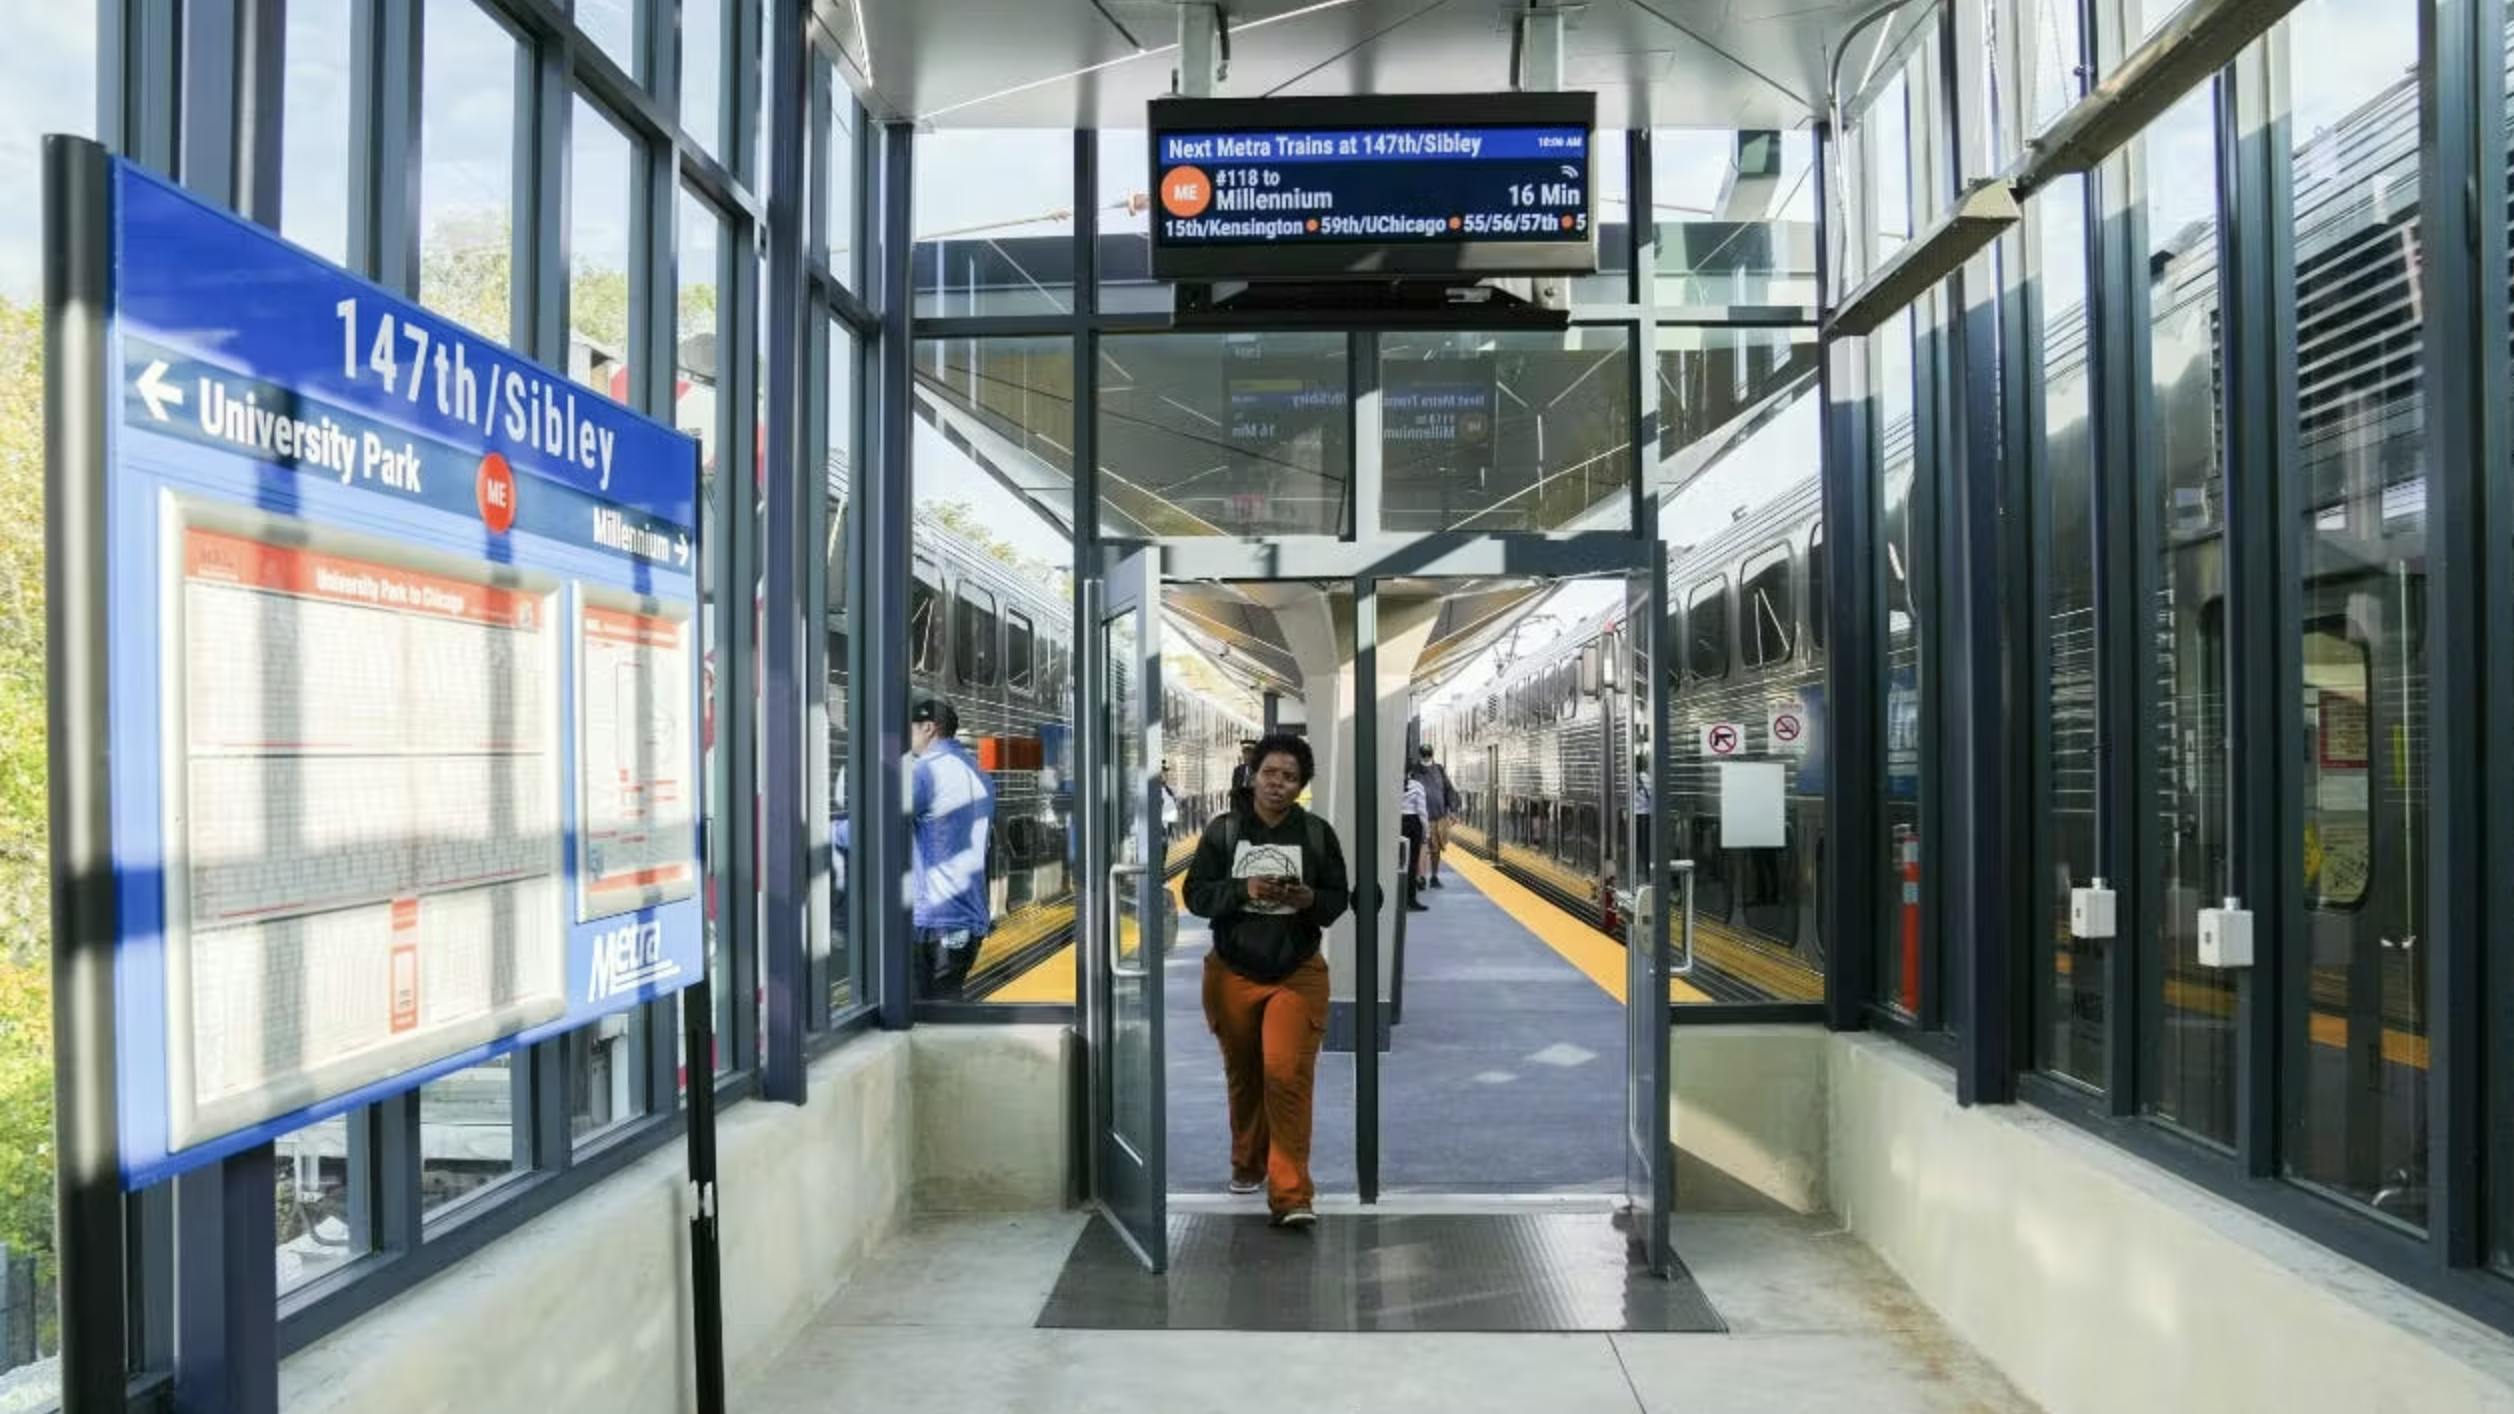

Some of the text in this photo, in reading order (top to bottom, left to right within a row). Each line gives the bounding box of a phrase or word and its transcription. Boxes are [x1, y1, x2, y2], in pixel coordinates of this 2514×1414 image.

[1168, 133, 1483, 159] Next Metra Trains at 147th/Sibley
[1566, 136, 1583, 147] AM
[1216, 168, 1281, 187] #118 to
[1173, 184, 1198, 201] ME
[1216, 188, 1334, 211] Millennium
[1508, 183, 1581, 206] 16 Min
[1165, 213, 1587, 239] 15th/Kensington 59th/UChicago 55/56/57th 5
[336, 298, 615, 491] 147th/Sibley
[200, 377, 422, 493] University Park
[487, 478, 507, 508] ME
[592, 506, 669, 562] Millennium
[587, 919, 662, 1003] Metra
